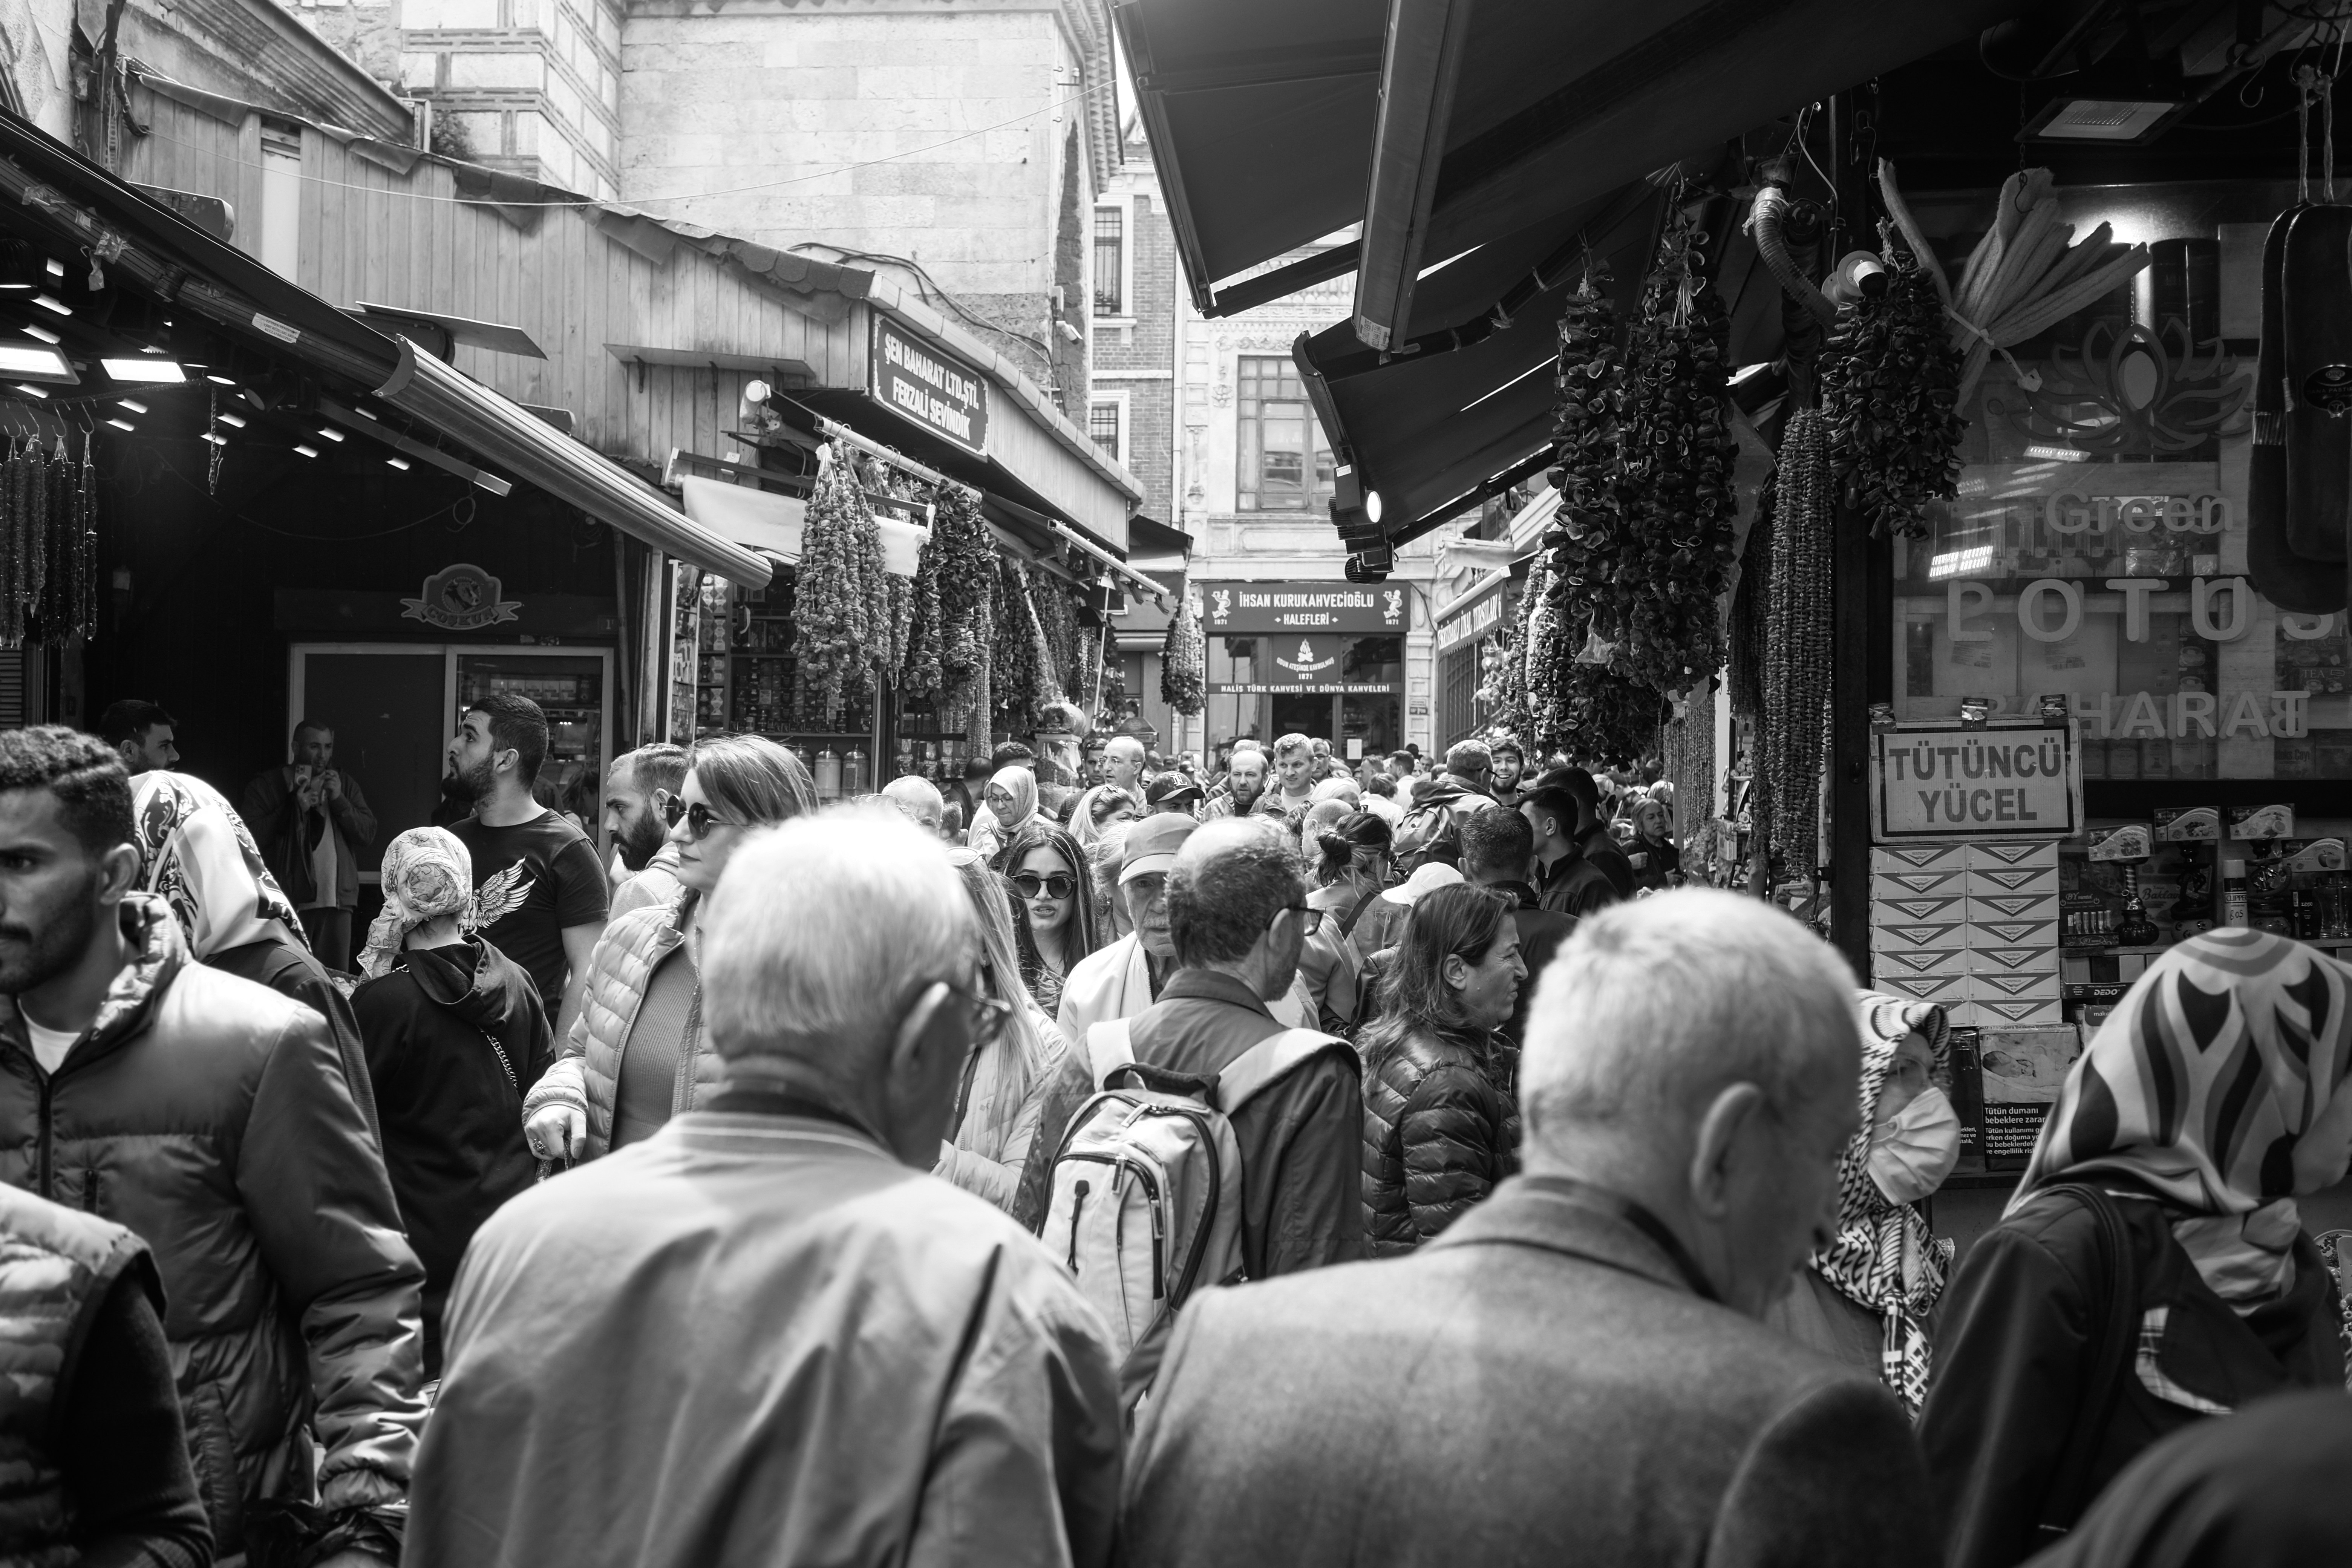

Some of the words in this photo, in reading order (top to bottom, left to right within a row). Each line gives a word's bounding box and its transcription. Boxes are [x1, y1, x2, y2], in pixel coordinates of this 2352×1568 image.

[885, 333, 903, 366] ŞEN
[904, 345, 944, 389] BAHARAT
[893, 376, 929, 419] FERZALİ
[929, 398, 971, 441] SEVİNDİK
[2046, 487, 2233, 534] Green
[1239, 591, 1271, 607] İHSAN
[1274, 591, 1374, 607] KURUKAHVECİOĞLU
[427, 606, 494, 626] COŞKUN
[1283, 612, 1329, 625] HALEFLERİ
[2302, 669, 2325, 678] TEA
[1221, 683, 1243, 692] HALİS
[1247, 684, 1267, 692] TÜRK
[1270, 683, 1303, 692] KAHVESİ
[1319, 684, 1344, 692] DÜNYA
[1348, 684, 1390, 692] KAHVELERİ
[1889, 738, 2061, 781] TÜTÜNCÜ
[1917, 783, 2038, 823] YÜCEL
[2142, 888, 2180, 900] Baklav
